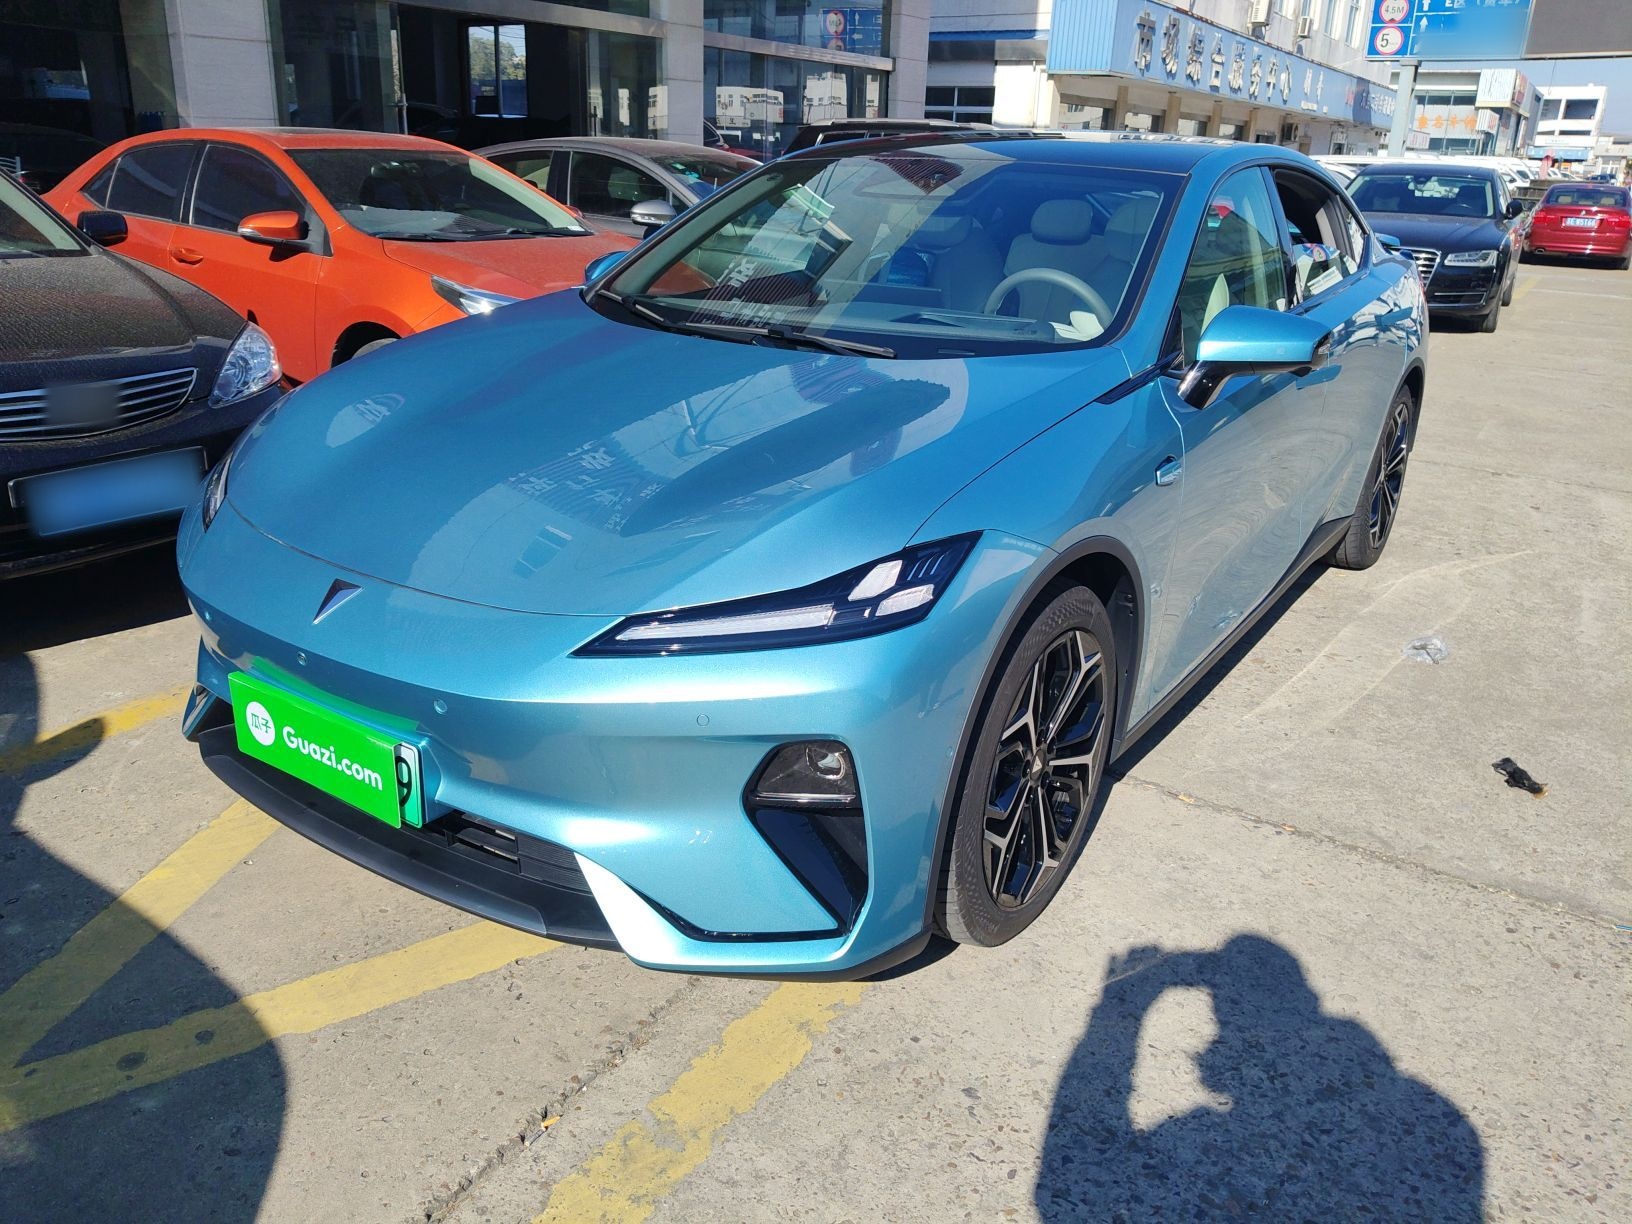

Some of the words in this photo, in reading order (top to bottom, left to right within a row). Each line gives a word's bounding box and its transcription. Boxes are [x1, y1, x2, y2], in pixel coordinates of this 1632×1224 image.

[1380, 33, 1390, 48] 5
[251, 713, 271, 733] 瓜子
[282, 725, 383, 791] Guazi.com
